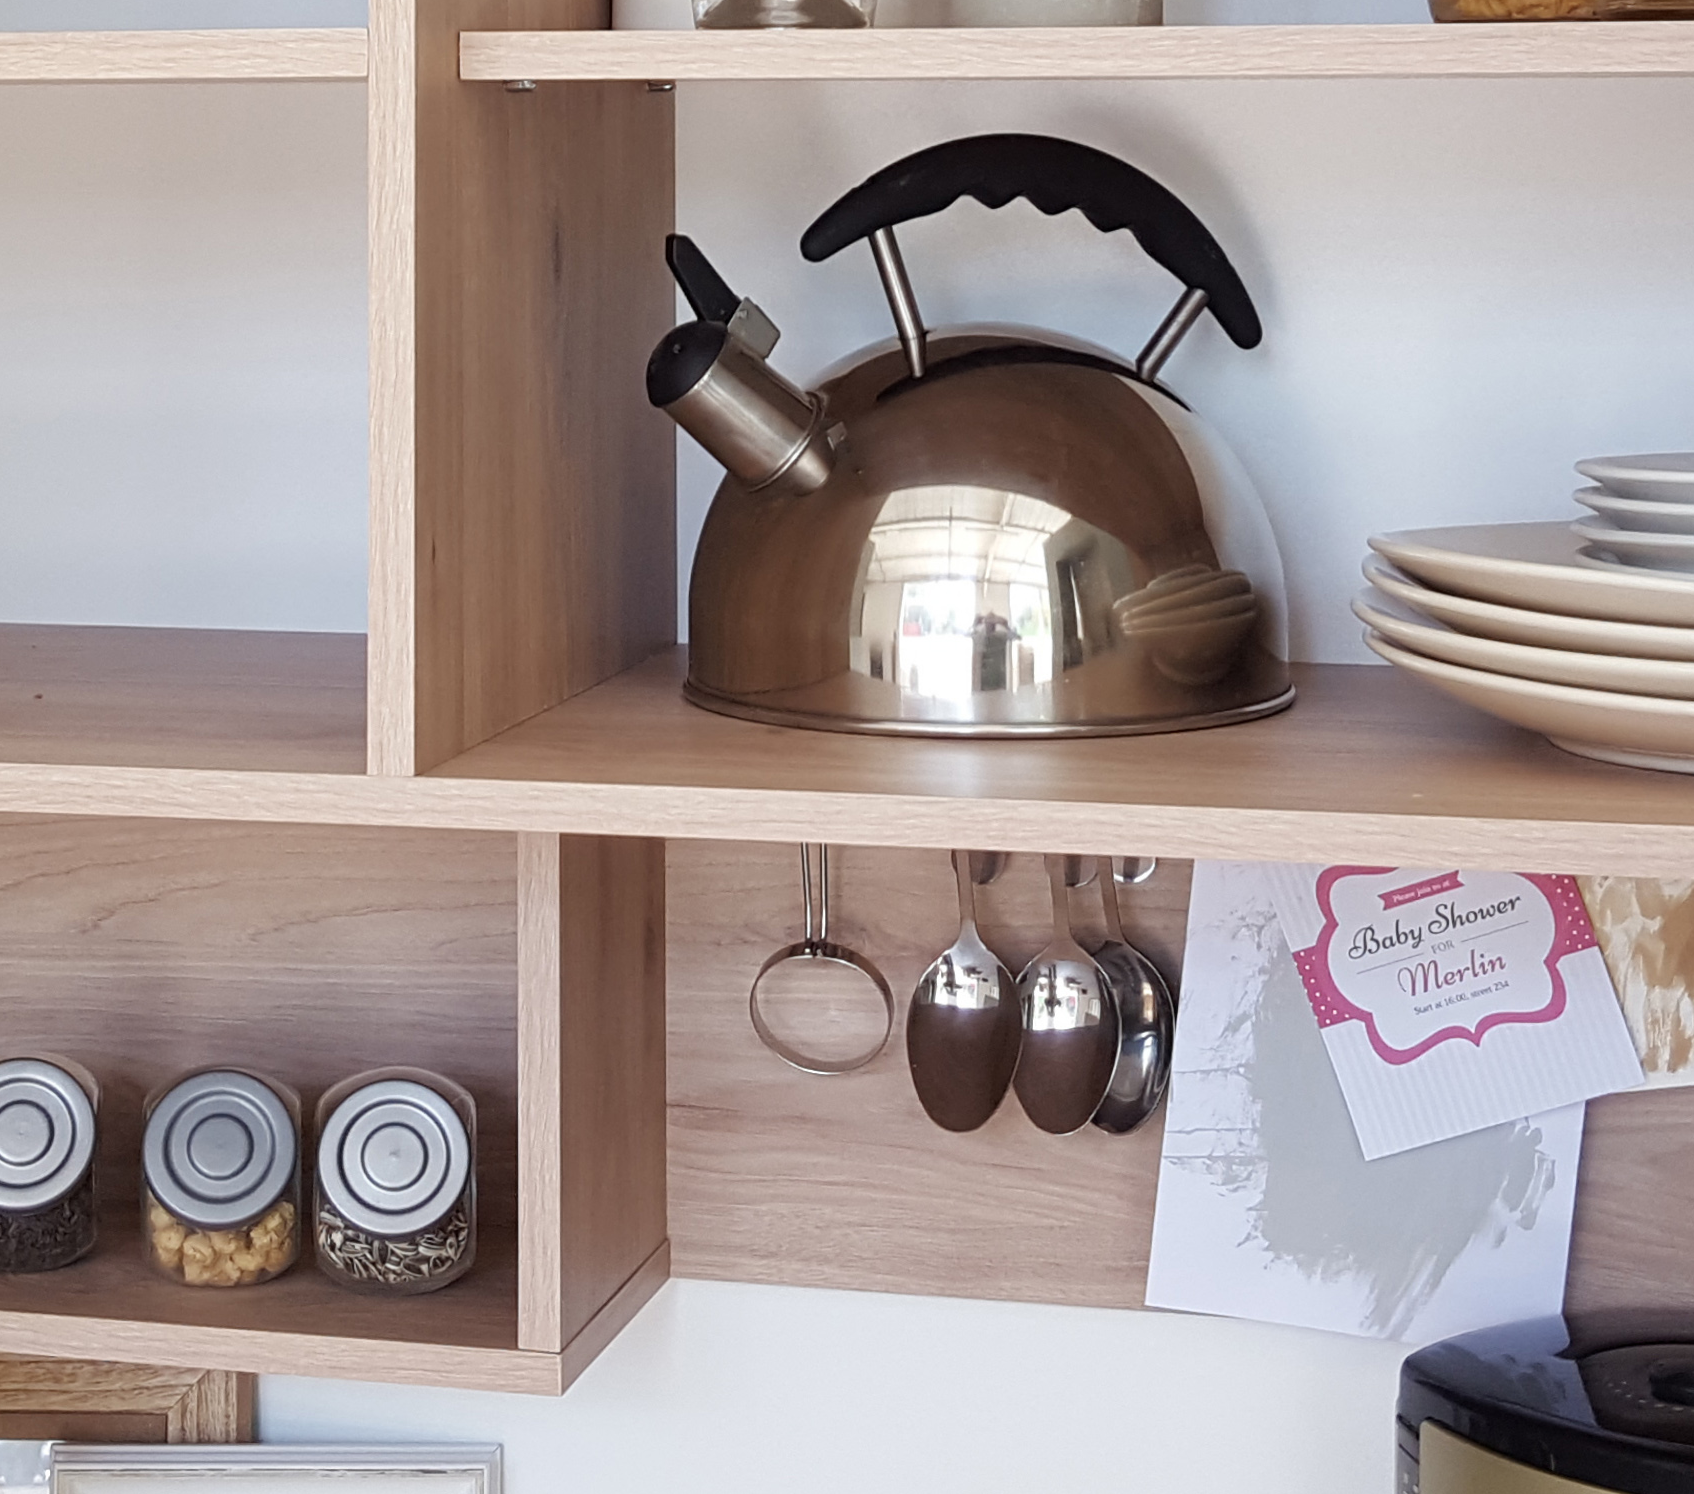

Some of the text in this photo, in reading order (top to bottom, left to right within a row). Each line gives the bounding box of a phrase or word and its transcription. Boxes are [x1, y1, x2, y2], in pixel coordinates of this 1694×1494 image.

[1392, 891, 1415, 903] Please
[1348, 896, 1521, 959] Baby Shower
[1431, 940, 1455, 954] FOR
[1397, 949, 1506, 996] Merlin
[1414, 1003, 1433, 1015] Start
[1470, 987, 1492, 997] street
